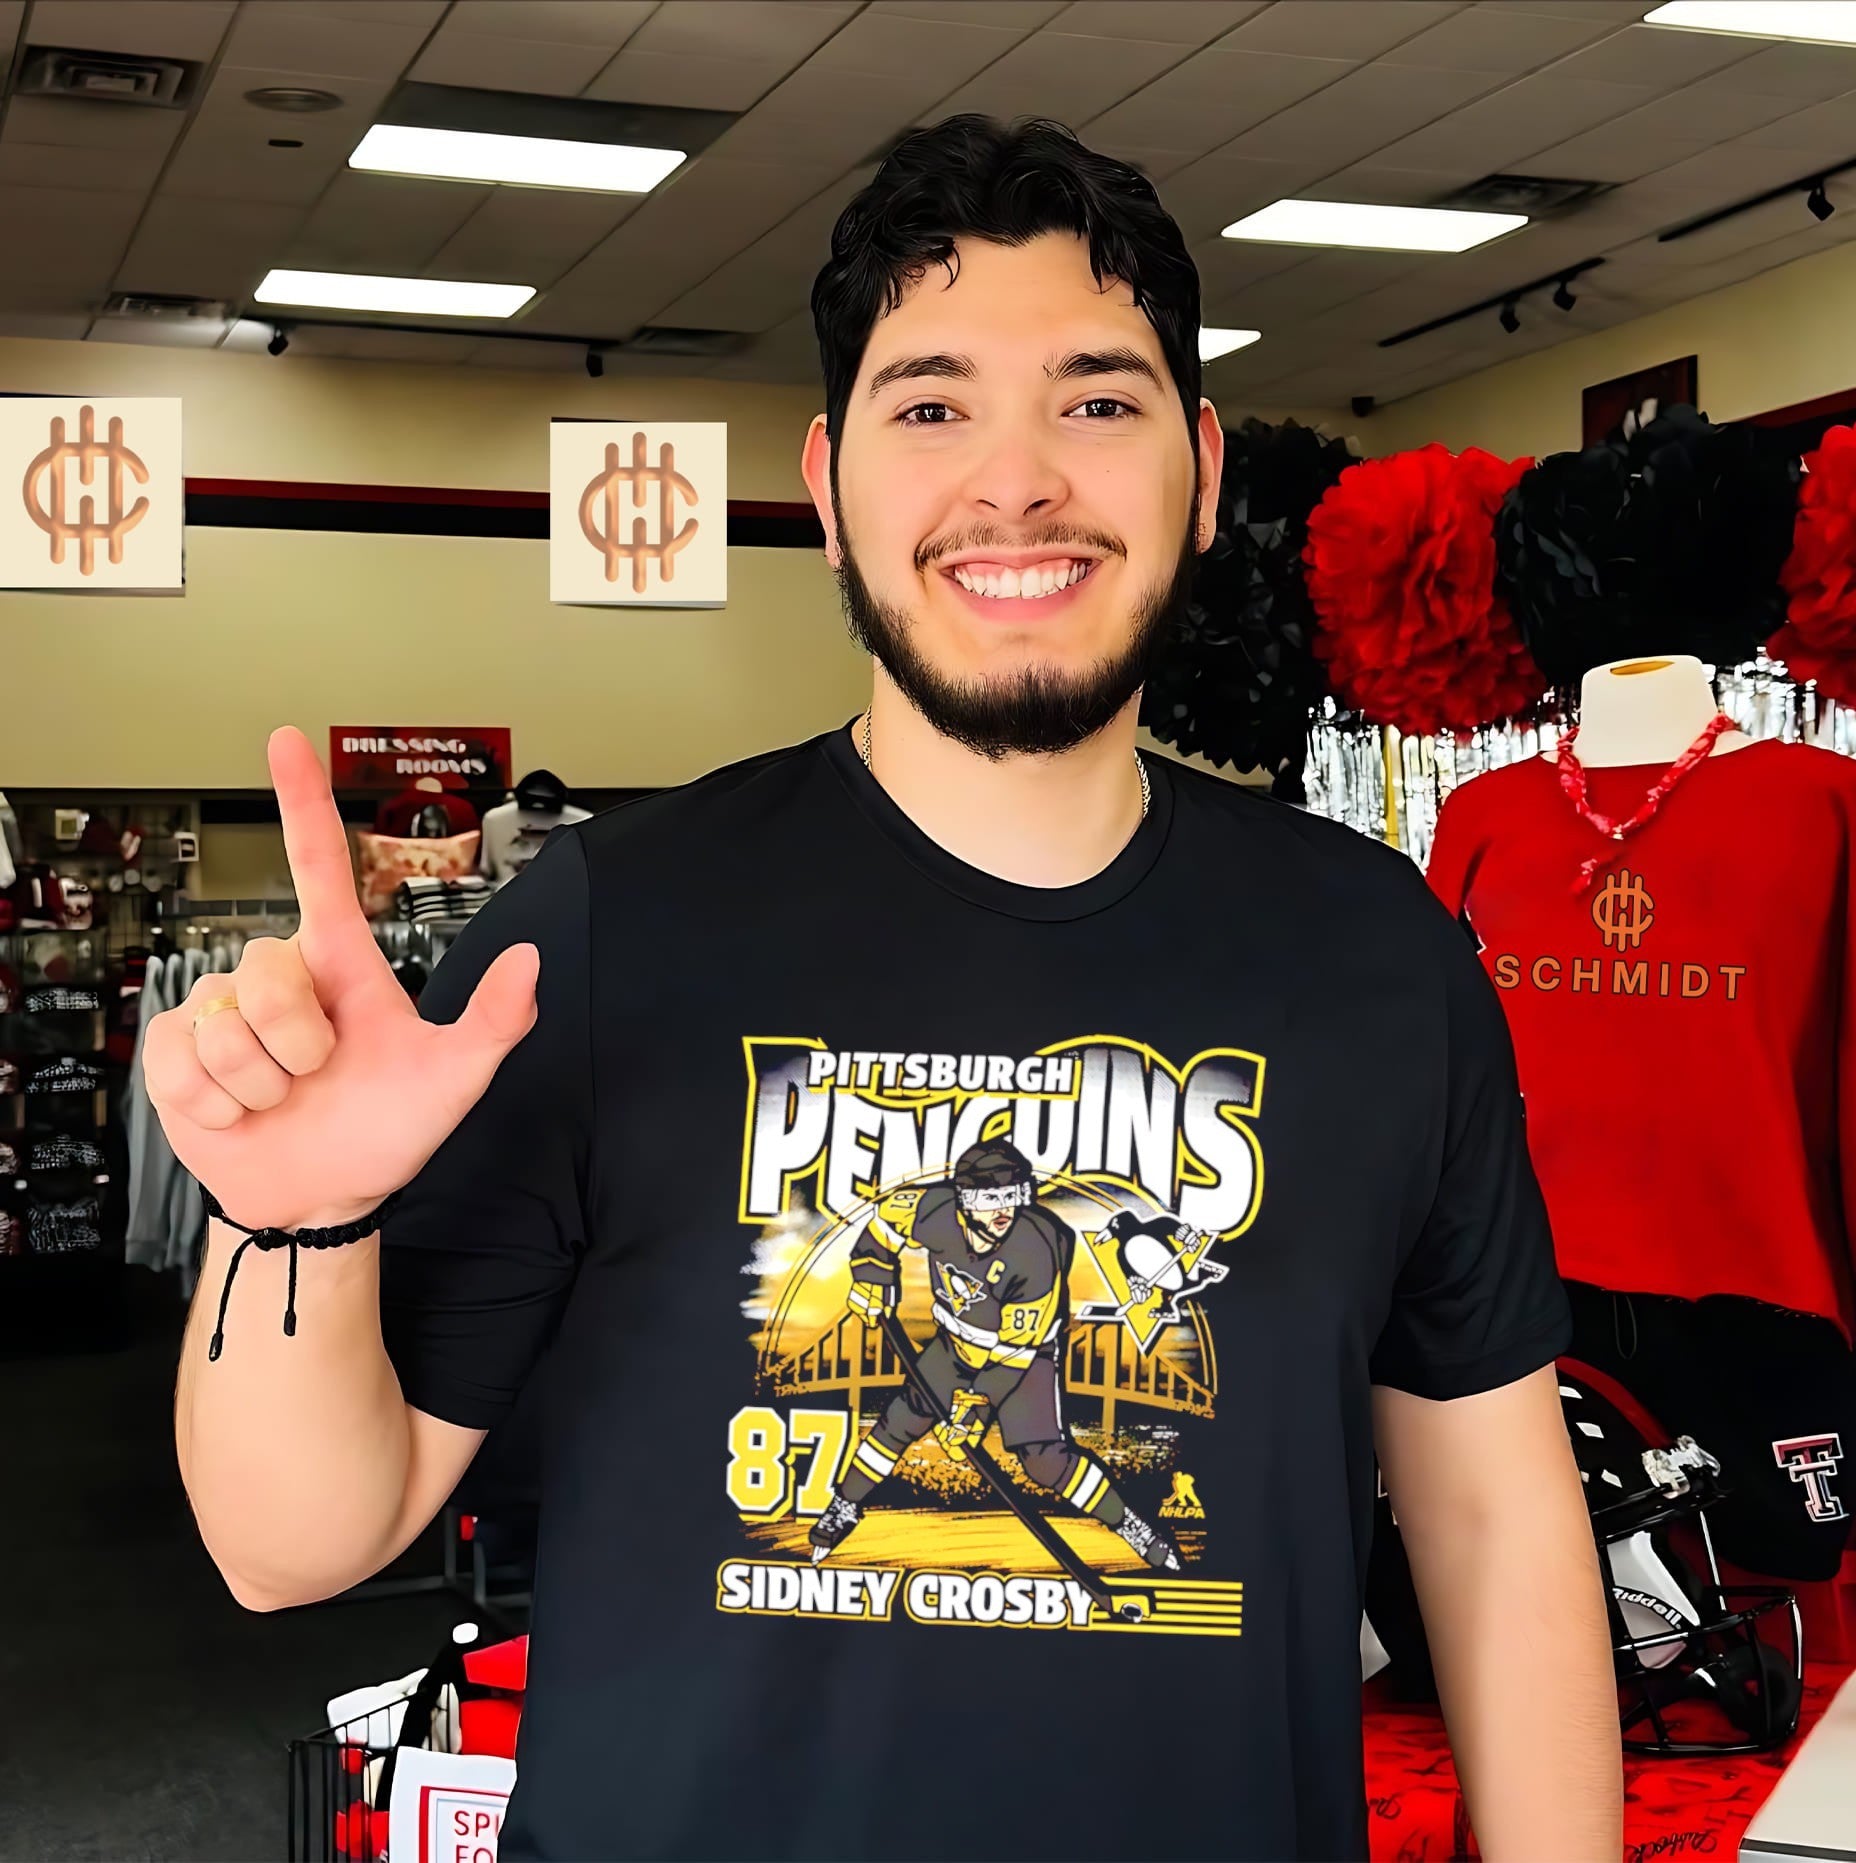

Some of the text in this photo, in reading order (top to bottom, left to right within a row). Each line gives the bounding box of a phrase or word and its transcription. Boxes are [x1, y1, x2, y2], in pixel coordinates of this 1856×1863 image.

[341, 737, 467, 754] DRESSING
[395, 758, 487, 775] ROOMS
[1495, 955, 1747, 1000] SCHMIDT
[807, 1050, 1074, 1093] PITTSBURGH
[742, 1038, 1262, 1237] PENGUINS
[986, 1259, 1006, 1284] C
[1012, 1308, 1041, 1332] 87
[726, 1406, 849, 1515] 87
[1158, 1505, 1206, 1519] NHLPA
[719, 1562, 1093, 1626] SIDNEY CROSBY
